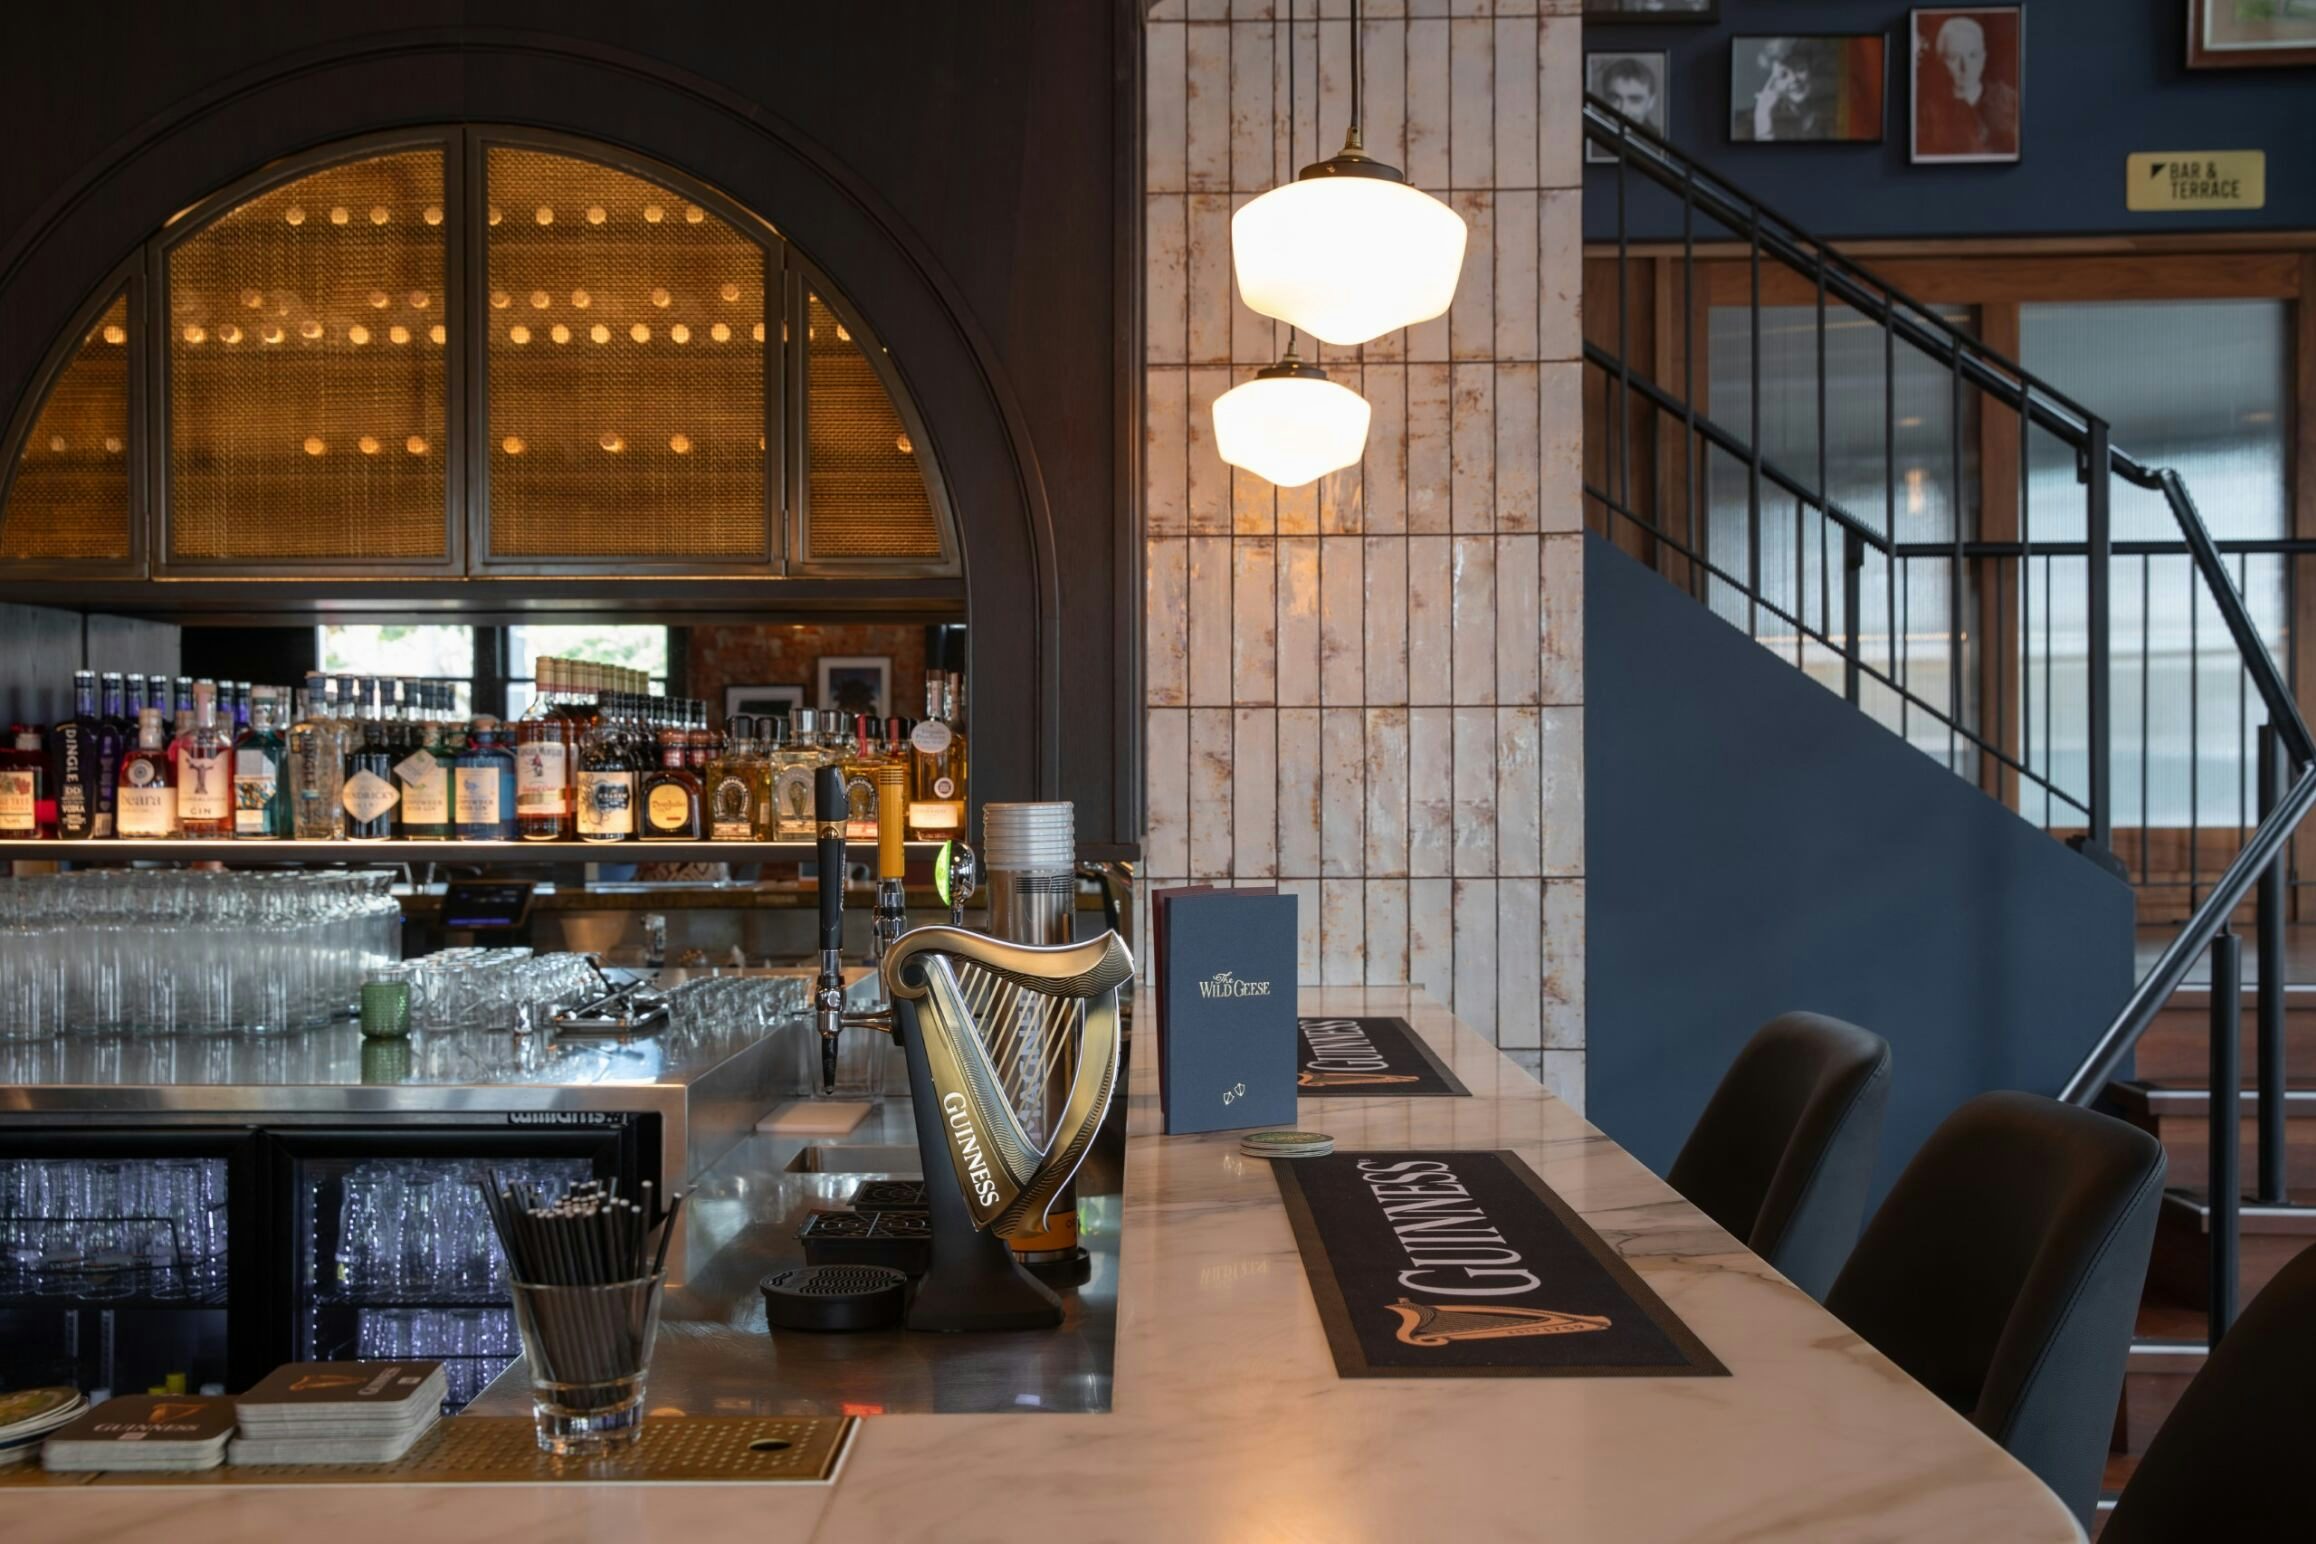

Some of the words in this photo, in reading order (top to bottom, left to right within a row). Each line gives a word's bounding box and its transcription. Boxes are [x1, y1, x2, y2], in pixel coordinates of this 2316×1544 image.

[2169, 162, 2200, 179] BAR
[2206, 162, 2217, 179] &
[2170, 180, 2240, 199] TERRACE
[65, 728, 79, 783] DINGLE
[1213, 971, 1233, 984] The
[1233, 979, 1271, 998] GEESE
[1298, 1020, 1390, 1071] GUINNESS
[943, 1091, 1000, 1207] GUINNESS
[1356, 1160, 1542, 1296] GUINNESS
[93, 1423, 200, 1432] GUINNESS
